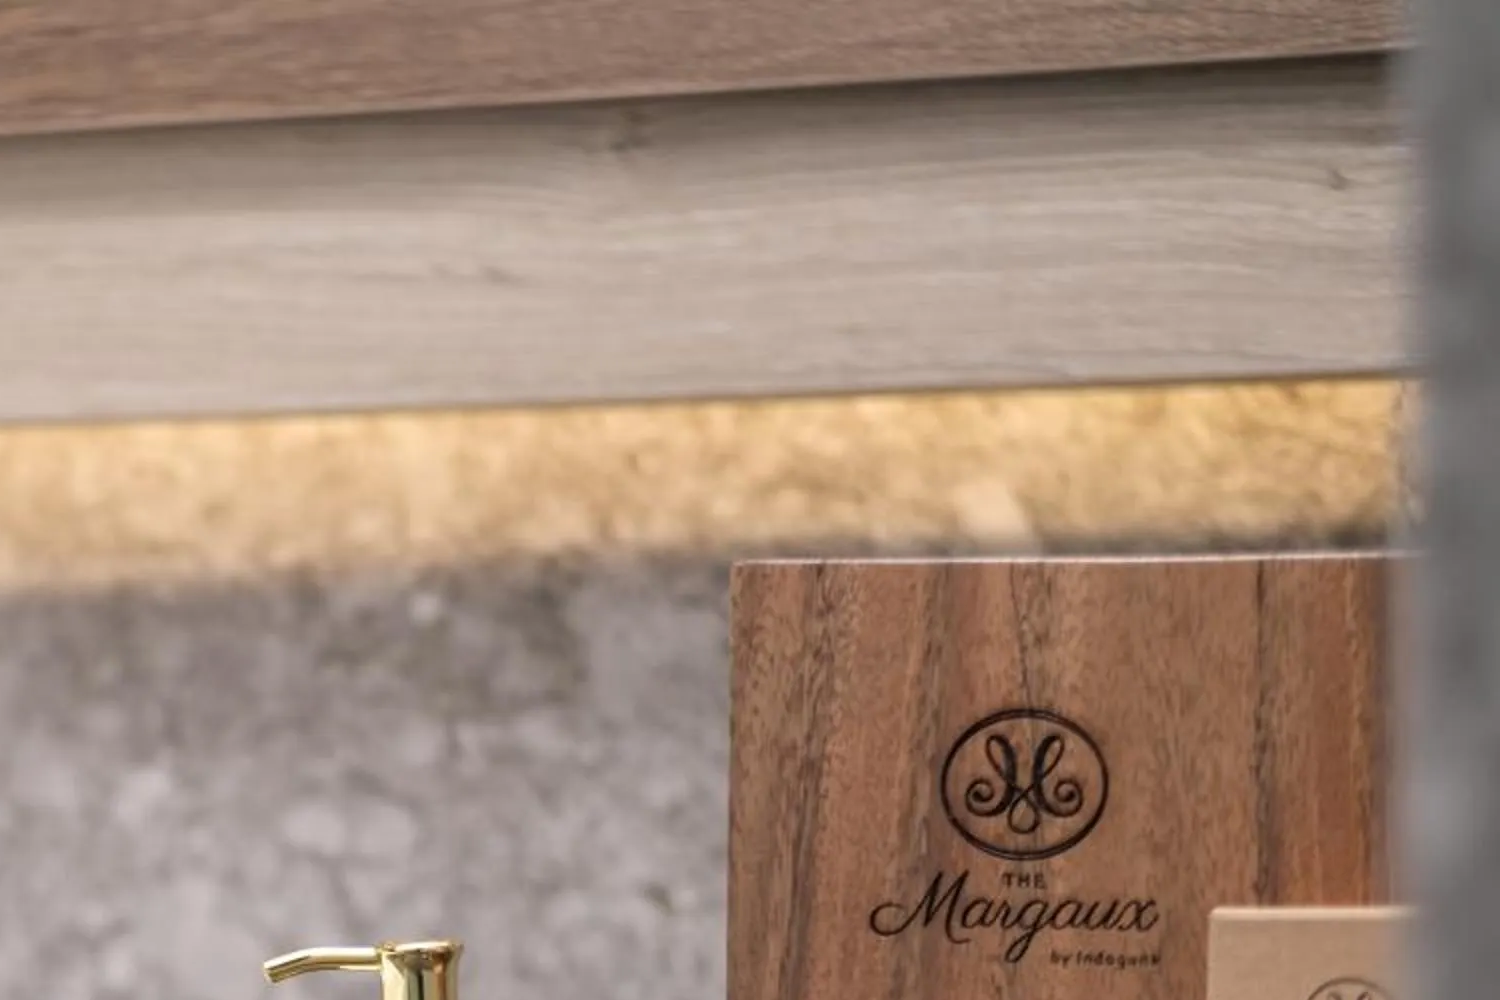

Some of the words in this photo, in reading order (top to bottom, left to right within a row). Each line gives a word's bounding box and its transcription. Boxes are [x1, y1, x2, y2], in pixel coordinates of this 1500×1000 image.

[1002, 872, 1046, 889] THE
[869, 869, 1160, 963] Margaux
[1050, 949, 1073, 969] by
